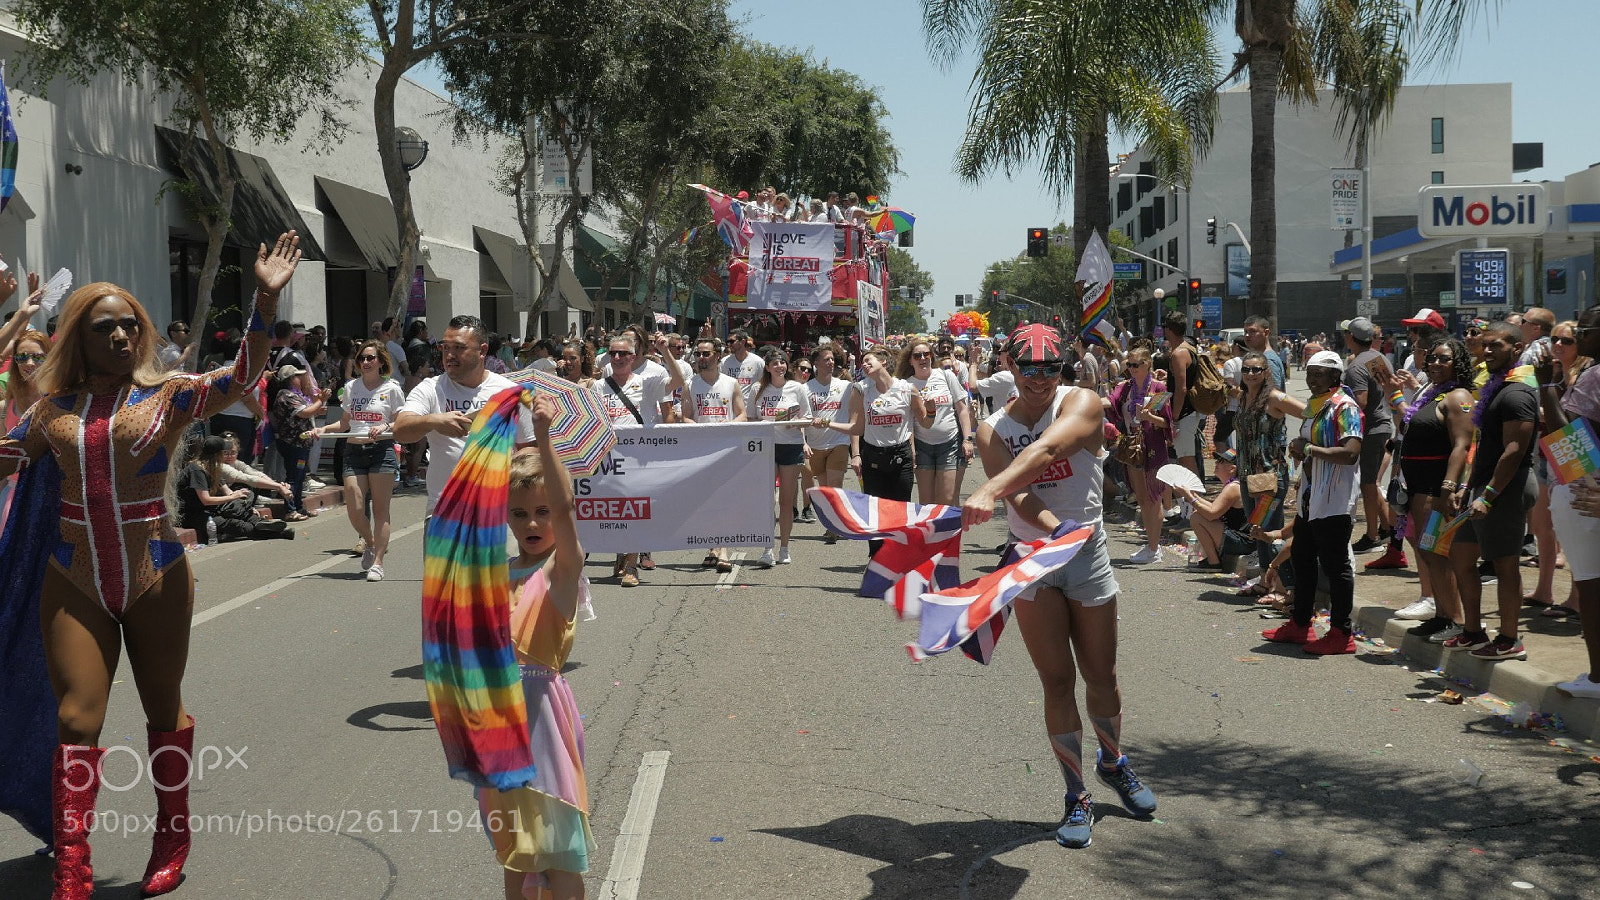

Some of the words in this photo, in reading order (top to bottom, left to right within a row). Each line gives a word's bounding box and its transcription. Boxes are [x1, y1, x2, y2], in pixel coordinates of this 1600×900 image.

[1332, 180, 1359, 190] ONE
[1433, 194, 1535, 226] Mobil
[774, 234, 806, 244] LOVE
[773, 245, 784, 255] IS
[774, 258, 818, 270] GREAT
[704, 407, 727, 415] GREAT
[873, 415, 902, 424] GREAT
[617, 437, 635, 445] Los
[638, 436, 678, 446] Angeles
[747, 440, 764, 452] 61
[574, 478, 592, 496] IS
[578, 500, 648, 518] GREAT
[687, 534, 771, 545] #lovegreatbritain
